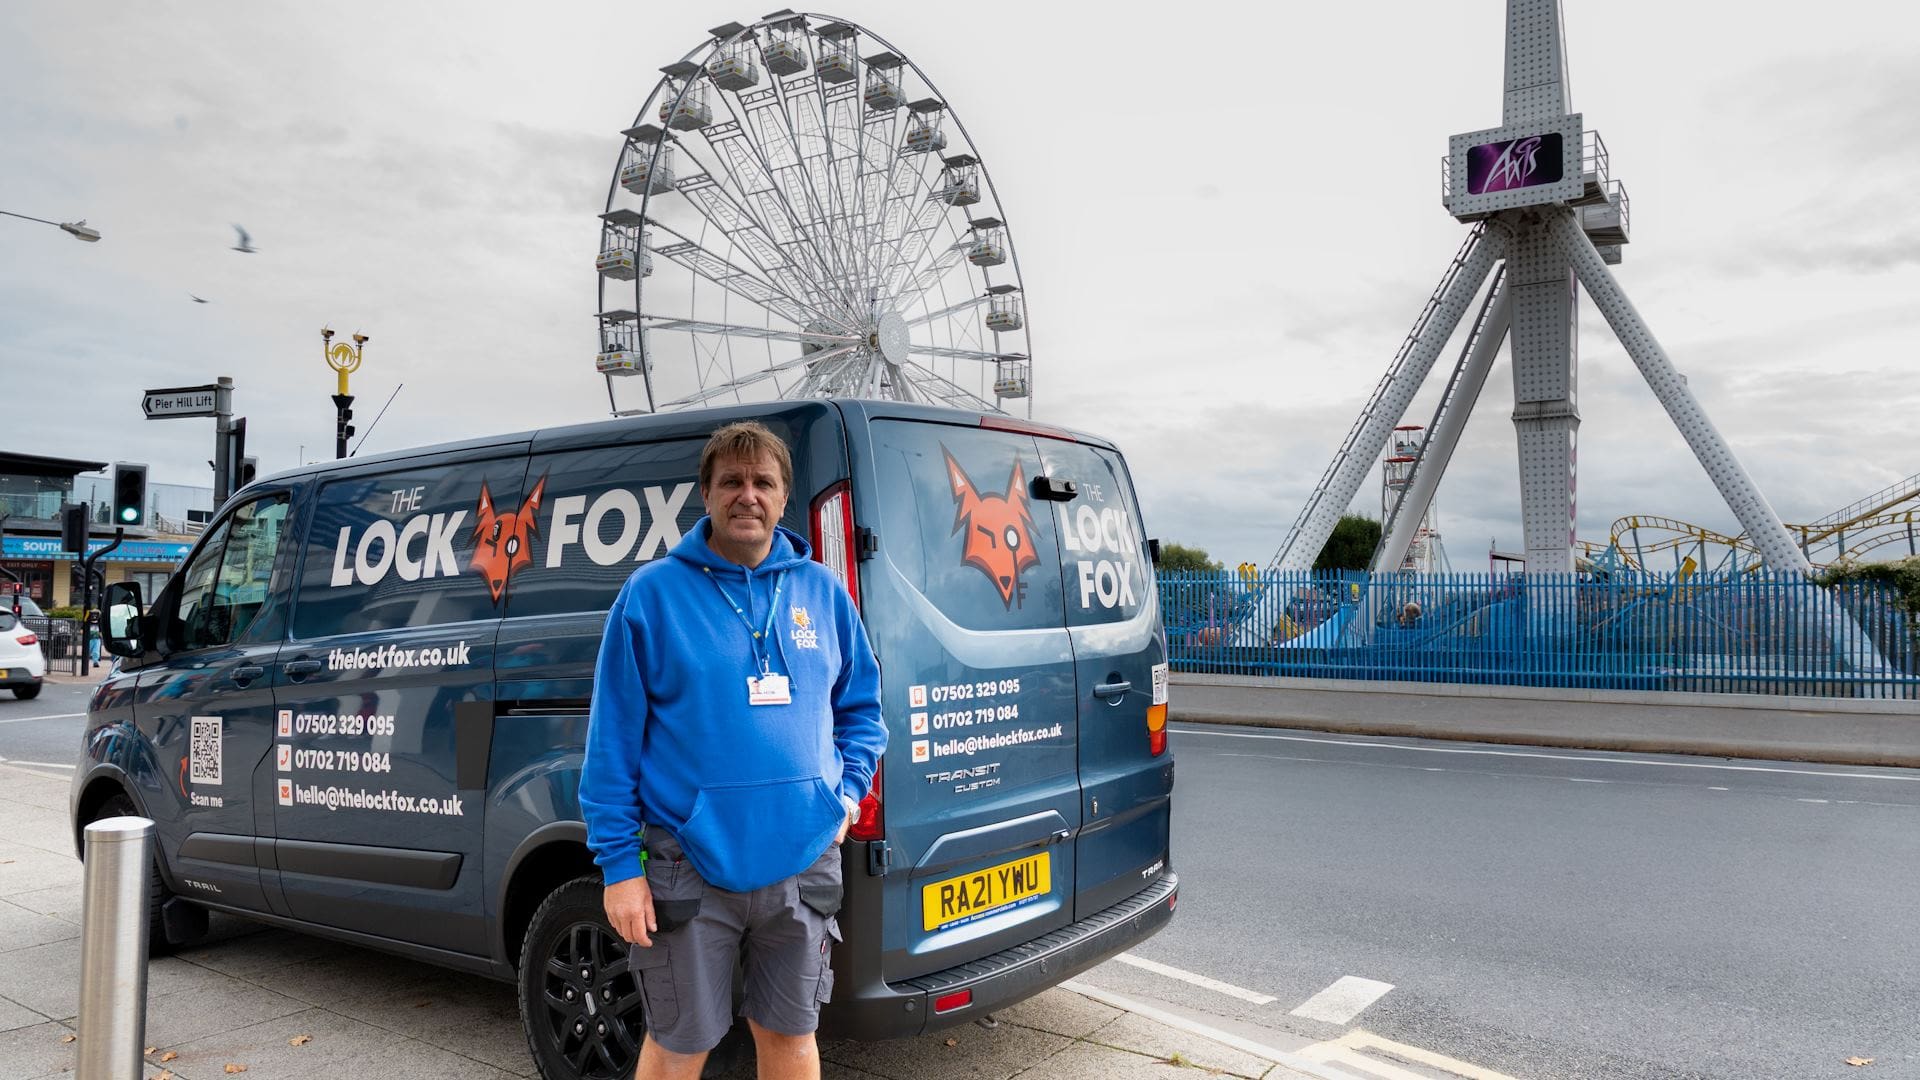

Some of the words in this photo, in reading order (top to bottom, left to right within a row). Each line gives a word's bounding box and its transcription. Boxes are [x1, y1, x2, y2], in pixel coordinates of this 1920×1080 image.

[155, 399, 173, 409] Pier
[176, 396, 193, 408] Hill
[196, 395, 212, 407] Lift
[391, 486, 425, 514] THE
[1083, 483, 1105, 503] THE
[330, 510, 469, 587] LOCK
[545, 482, 696, 569] FOX
[1058, 503, 1136, 555] LOCK
[23, 541, 61, 551] SOUTH
[1077, 559, 1136, 609] FOX
[791, 630, 818, 640] LOCK
[796, 639, 818, 649] FOX
[328, 641, 471, 670] thelockfox.co.uk
[931, 684, 973, 702] 07502
[975, 681, 997, 697] 329
[999, 679, 1020, 694] 095
[296, 714, 336, 734] 07502
[339, 715, 364, 735] 329
[367, 715, 395, 736] 095
[932, 711, 973, 729] 01702
[975, 708, 995, 723] 719
[997, 704, 1018, 719] 084
[933, 723, 1063, 757] hello@thelockfox.co.uk
[295, 750, 334, 770] 01702
[337, 752, 359, 772] 719
[362, 752, 391, 773] 084
[925, 762, 1000, 784] TRANSIT
[954, 778, 1000, 793] CUSTOM
[190, 792, 210, 806] Scan
[210, 796, 223, 808] me
[296, 784, 463, 816] hello@thelockfox.co.uk
[184, 879, 222, 893] TRAIL
[940, 873, 992, 918] RA21
[998, 860, 1038, 900] YWU
